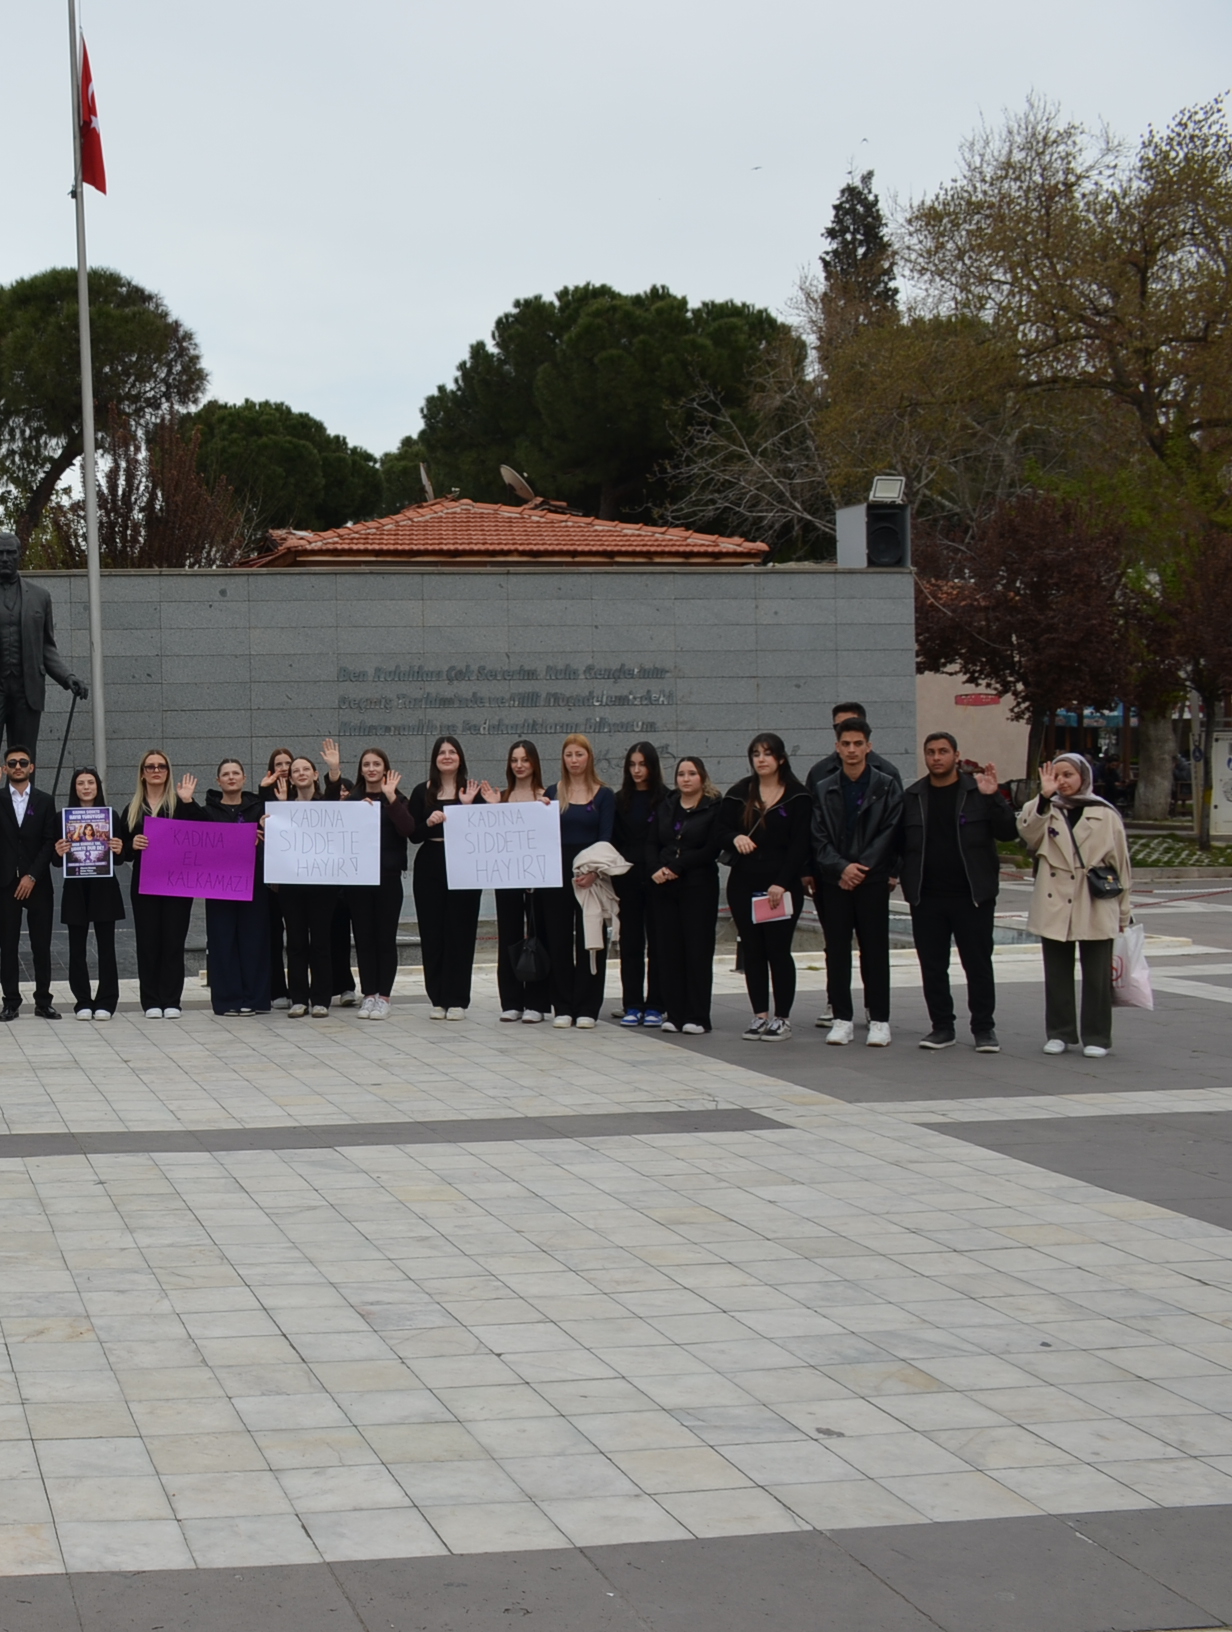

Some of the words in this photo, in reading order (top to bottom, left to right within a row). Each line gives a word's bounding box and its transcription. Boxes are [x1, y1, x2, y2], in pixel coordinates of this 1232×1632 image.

[337, 666, 368, 682] Ben
[446, 664, 475, 685] Çok
[545, 664, 580, 680] Kula
[338, 694, 393, 712] Geçmiş
[183, 851, 203, 867] EL
[297, 857, 358, 878] HAYIR!
[476, 855, 546, 883] HAYIR!
